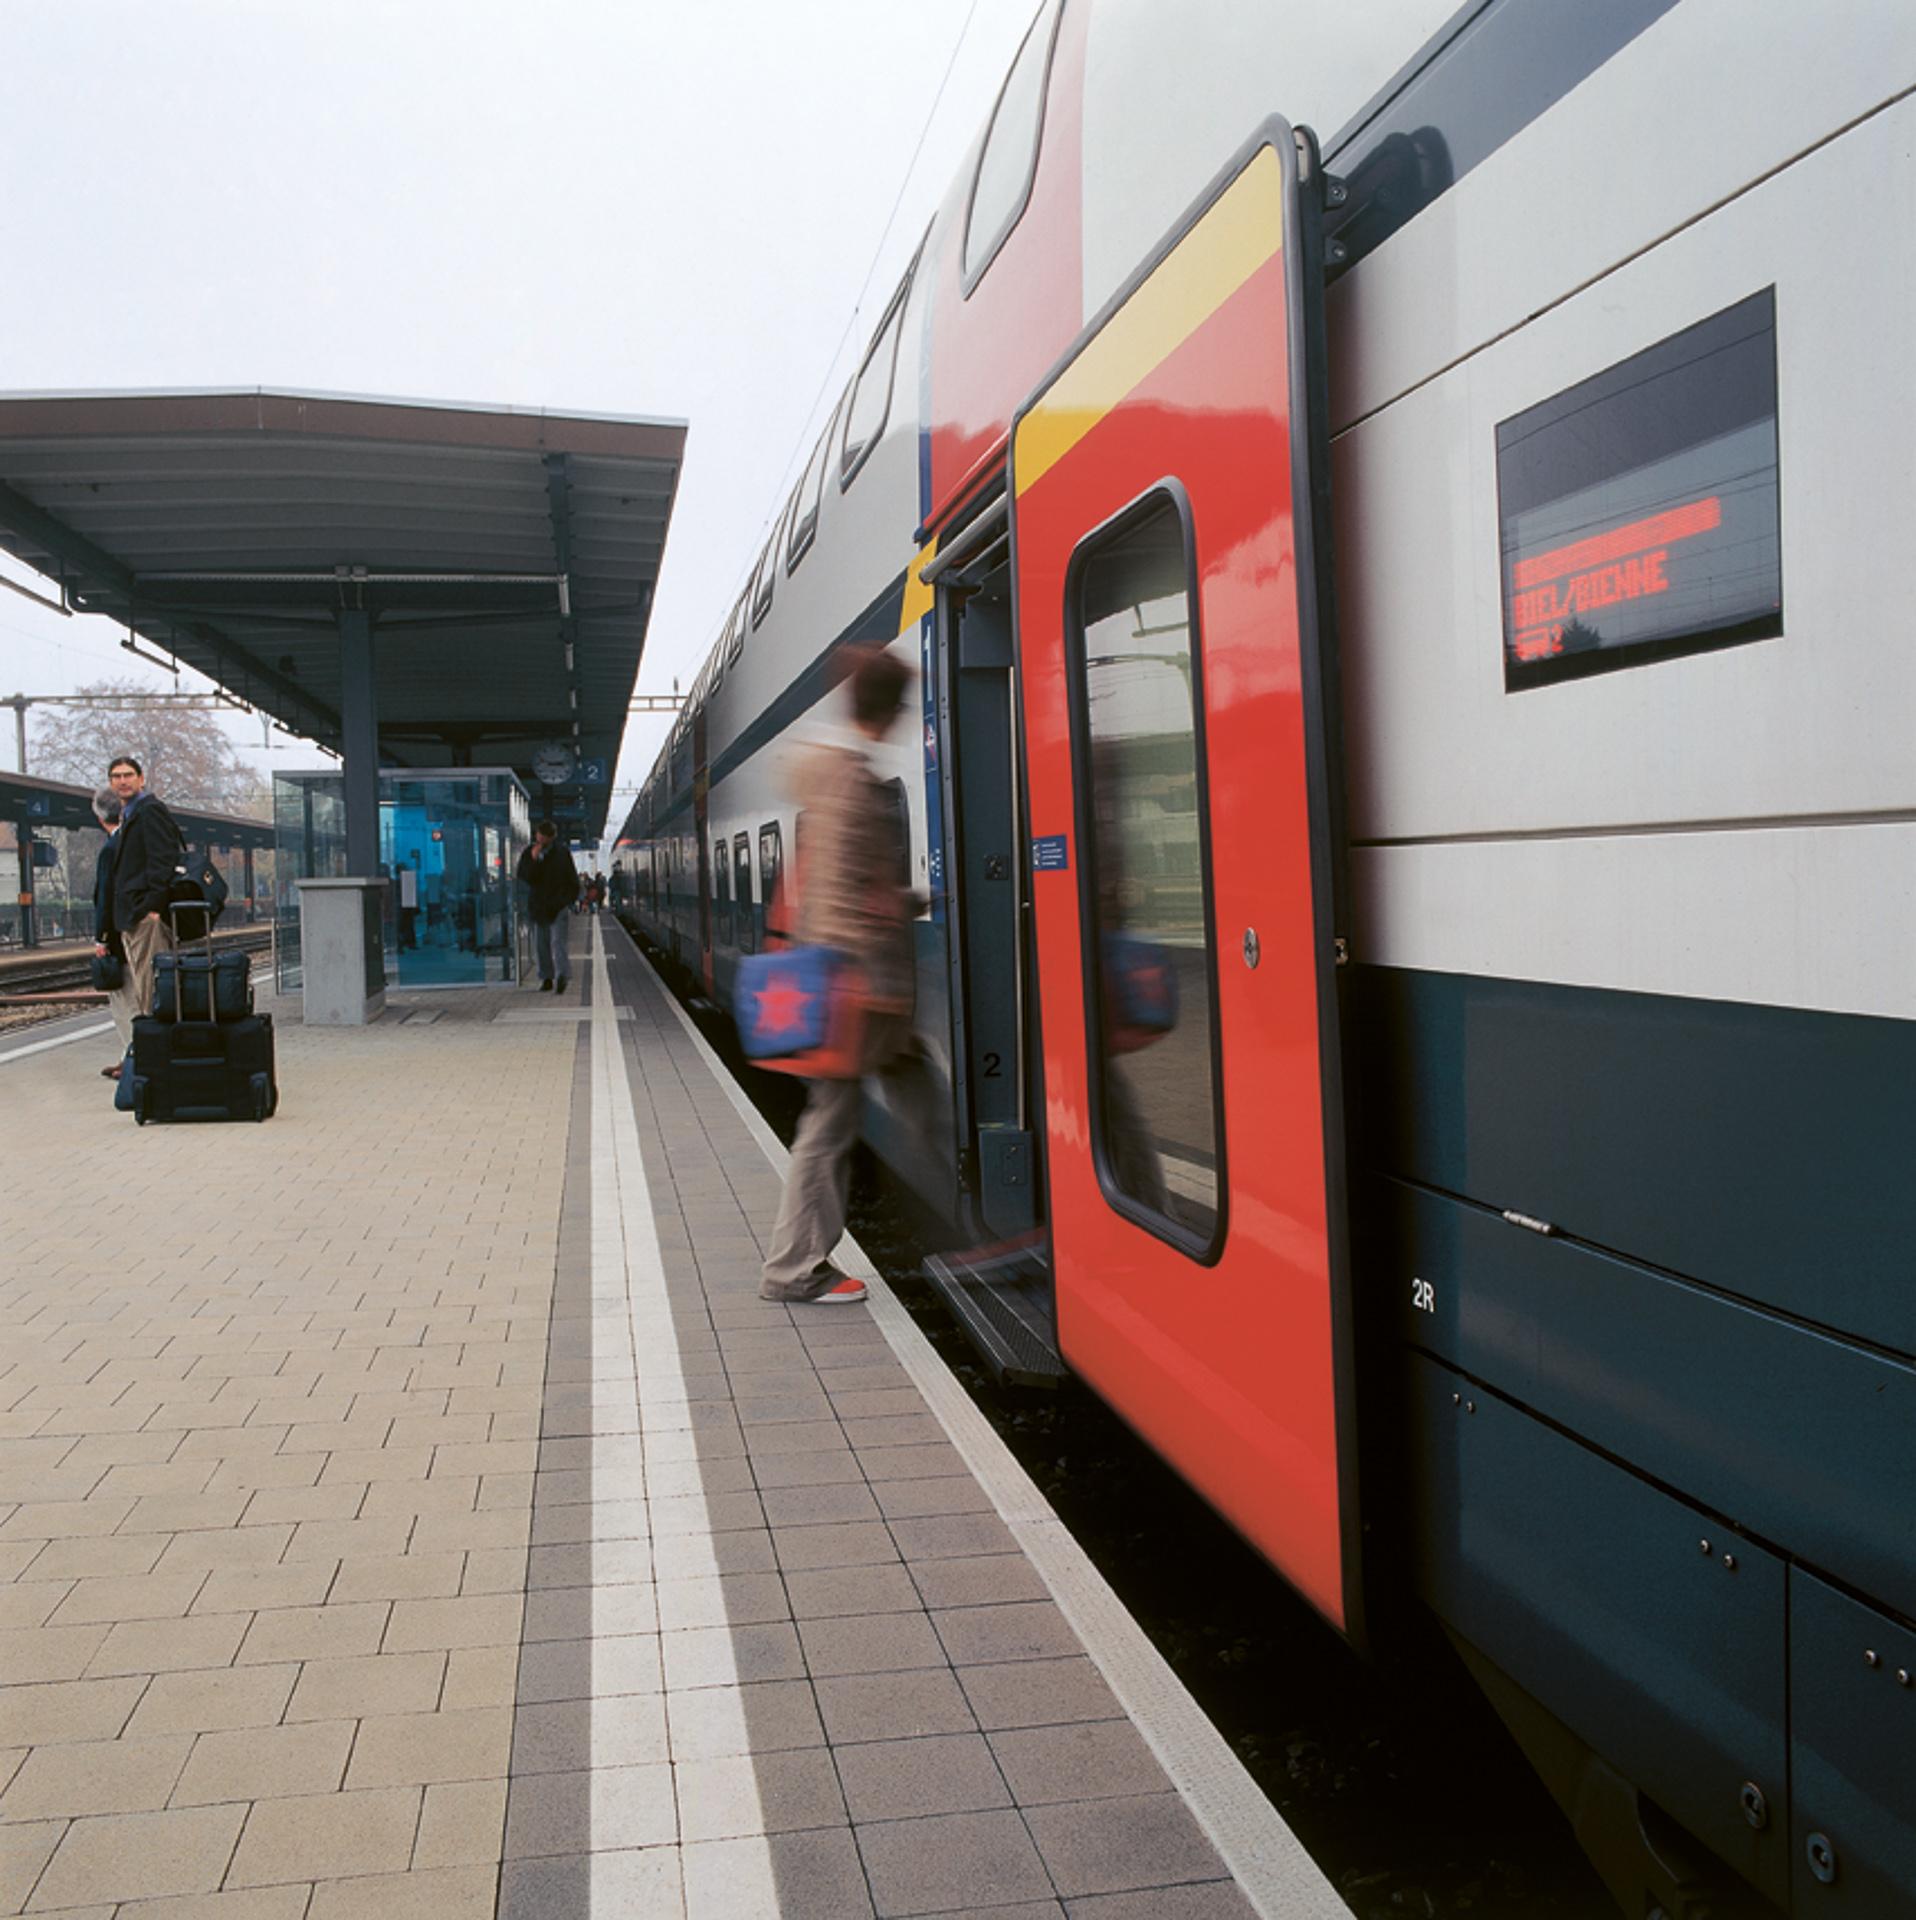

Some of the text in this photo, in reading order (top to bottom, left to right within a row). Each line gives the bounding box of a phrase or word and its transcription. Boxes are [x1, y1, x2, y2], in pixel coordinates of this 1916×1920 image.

[588, 765, 599, 780] 2
[984, 1053, 1002, 1078] 2
[1412, 1277, 1434, 1312] 2R
